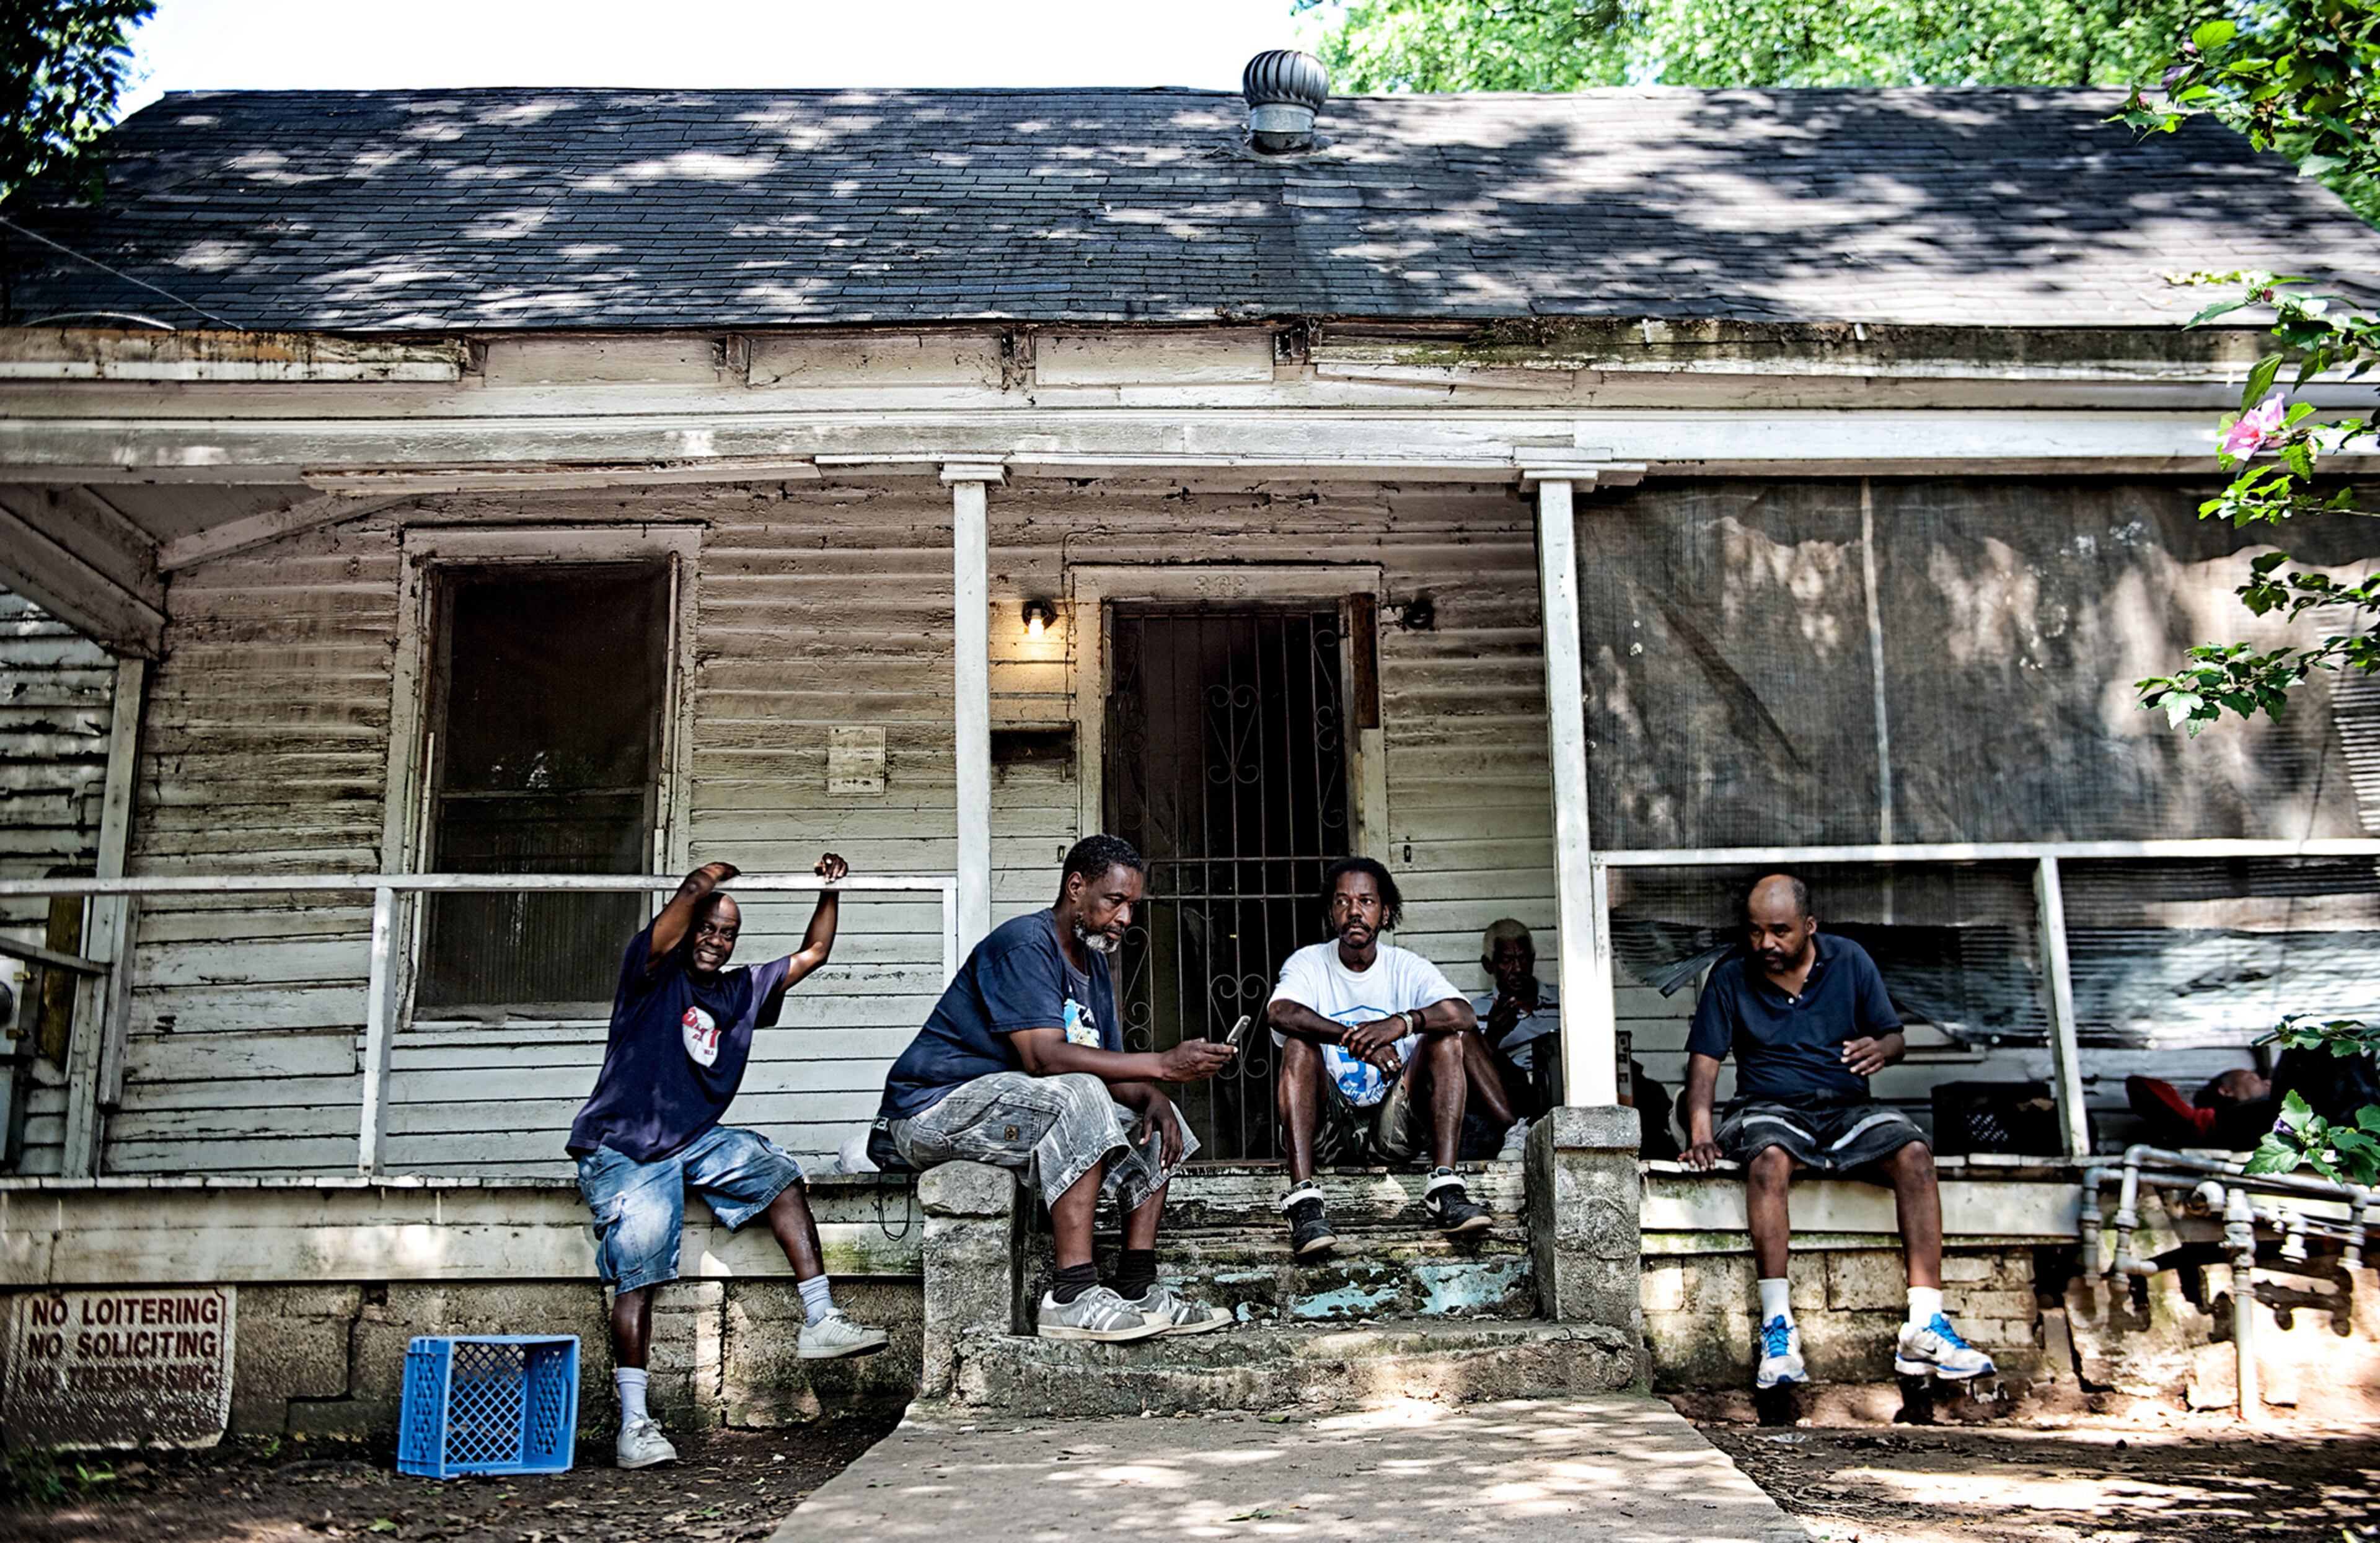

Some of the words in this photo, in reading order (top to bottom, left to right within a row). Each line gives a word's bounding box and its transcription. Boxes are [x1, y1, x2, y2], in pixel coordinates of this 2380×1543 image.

[32, 1298, 68, 1326] NO
[82, 1298, 218, 1325] LOITERING
[27, 1332, 63, 1360] NO
[76, 1330, 217, 1360] SOLICITING
